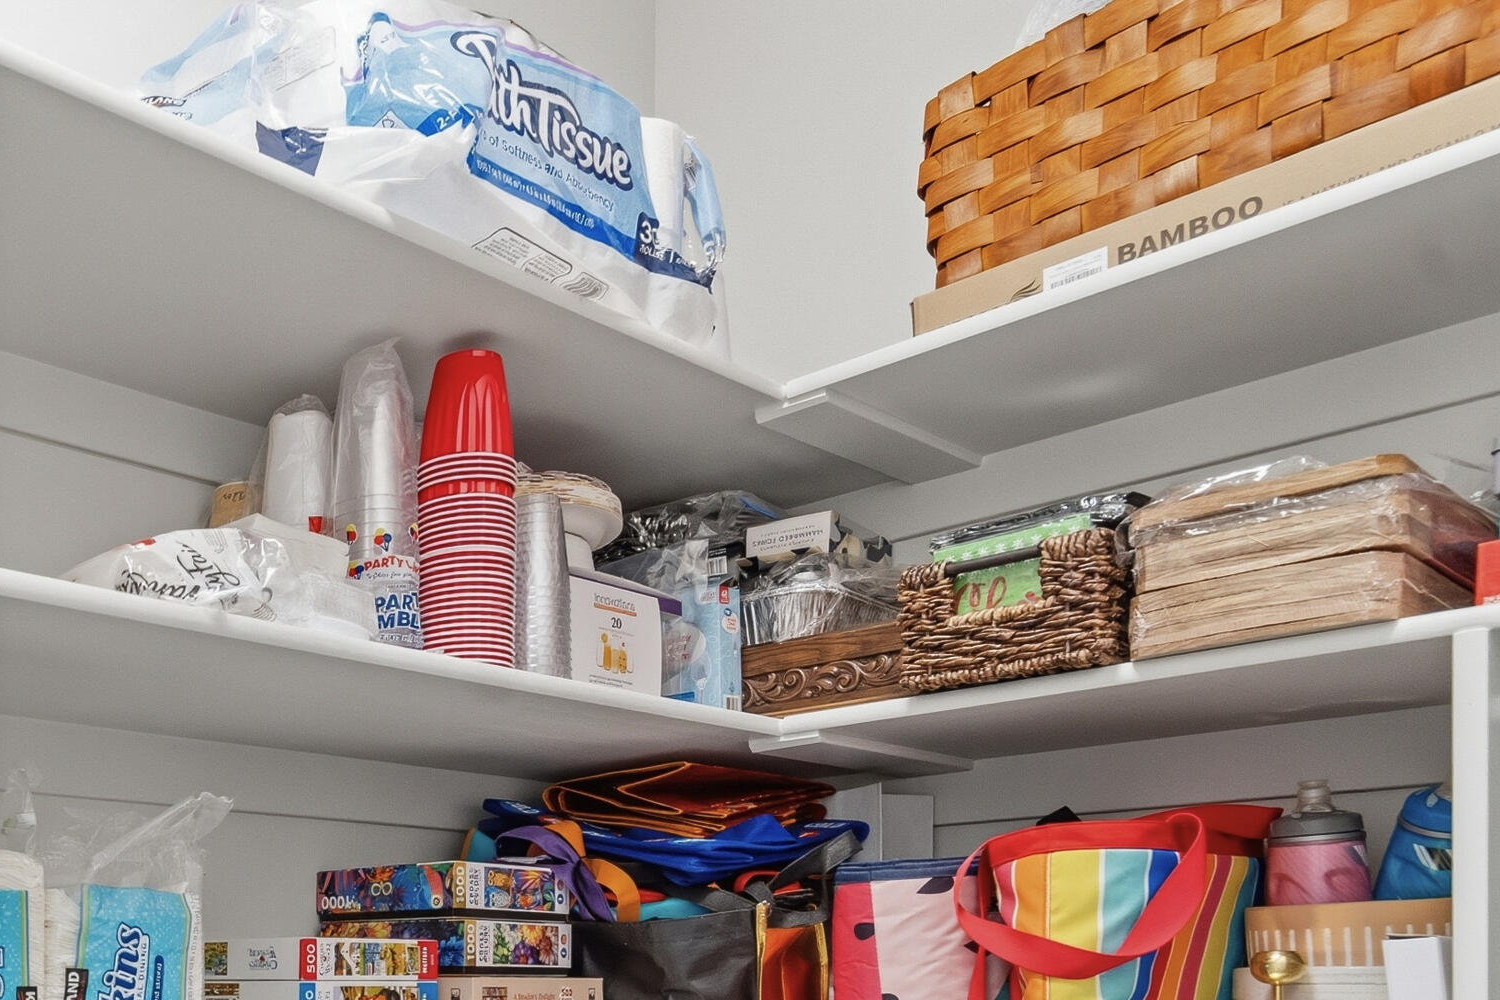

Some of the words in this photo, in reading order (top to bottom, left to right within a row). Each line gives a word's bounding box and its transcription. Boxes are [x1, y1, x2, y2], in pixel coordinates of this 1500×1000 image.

[515, 84, 634, 191] Tissue
[1117, 196, 1264, 264] BAMBOO
[364, 555, 404, 571] PARTY
[374, 592, 420, 613] PART
[610, 617, 623, 629] 20
[306, 943, 316, 973] 500
